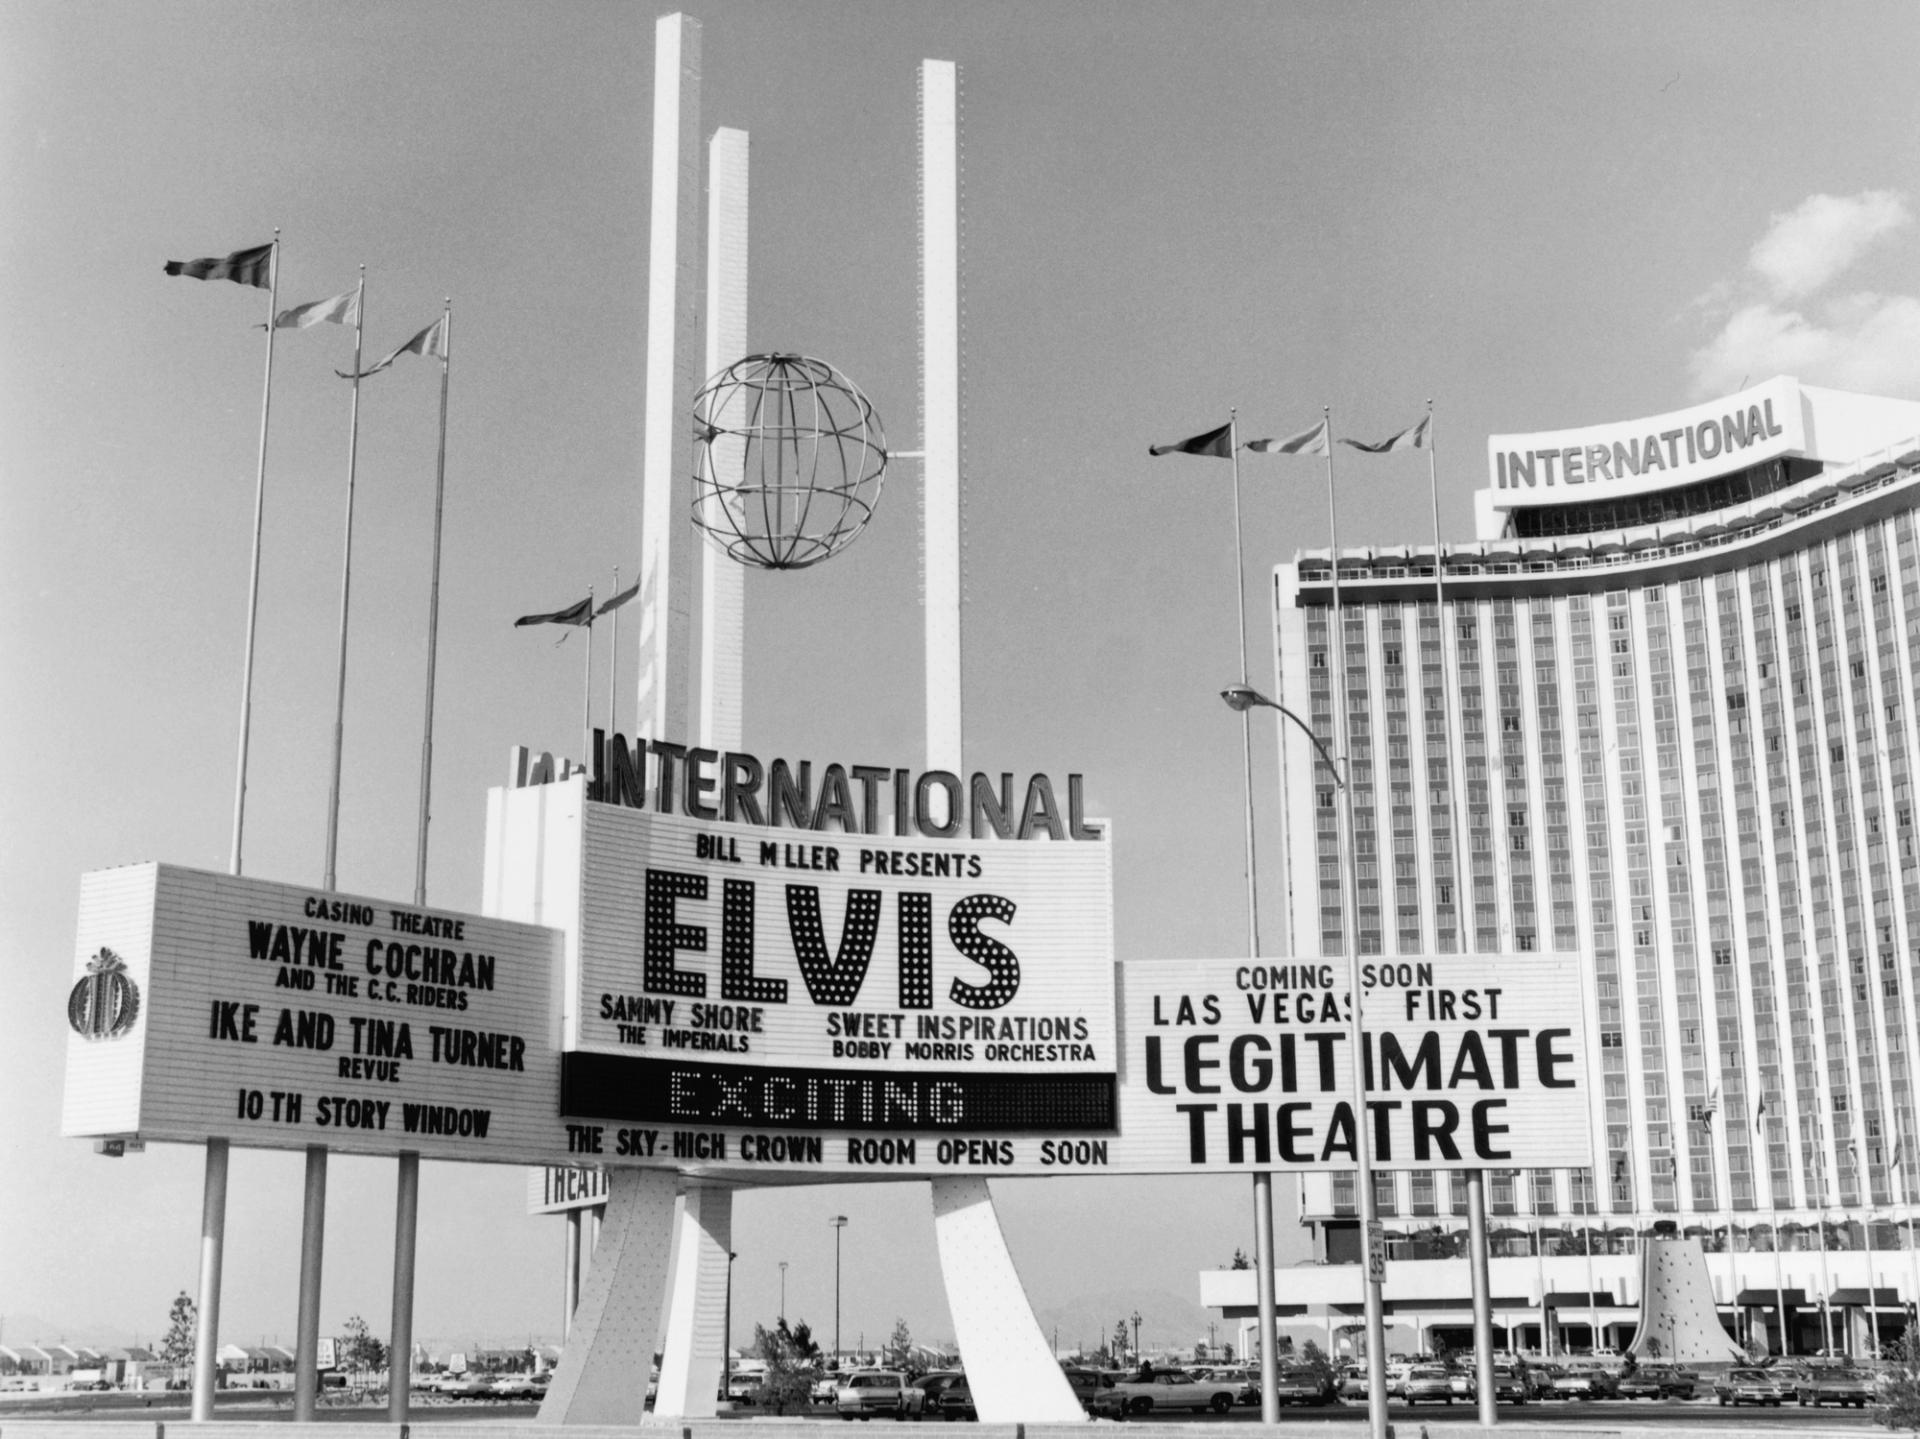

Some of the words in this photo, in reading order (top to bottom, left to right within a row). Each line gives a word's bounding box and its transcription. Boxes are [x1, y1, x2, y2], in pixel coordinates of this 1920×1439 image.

[1496, 397, 1783, 489] INTERNATIONAL
[588, 728, 1106, 841] INTERNATIONAL
[696, 833, 741, 862] BILL
[860, 848, 982, 878] PRESENTS
[304, 897, 375, 926] CASINO
[390, 910, 465, 941] THEATRE
[644, 868, 1022, 1010] ELVIS
[248, 920, 346, 971] WAYNE
[366, 938, 496, 991] COCHRAN
[1236, 964, 1333, 990] COMING
[1361, 963, 1433, 988] SOON
[275, 966, 316, 992] AND
[324, 972, 359, 998] THE
[406, 983, 468, 1011] RIDERS
[1154, 995, 1222, 1026] LAS
[1405, 988, 1502, 1021] FIRST
[600, 993, 676, 1026] SAMMY
[690, 1002, 764, 1033] SHORE
[826, 1012, 905, 1039] SWEET
[917, 1014, 1089, 1041] INSPIRATIONS
[209, 1000, 260, 1043] IKE
[273, 1008, 335, 1051] AND
[349, 1016, 414, 1060] TINA
[429, 1025, 526, 1072] TURNER
[617, 1024, 646, 1045] THE
[662, 1028, 749, 1053] IMPERIALS
[832, 1039, 892, 1059] BOBBY
[905, 1042, 975, 1061] MORRIS
[984, 1043, 1097, 1062] ORCHESTRA
[338, 1056, 400, 1083] REVUE
[1145, 1028, 1576, 1095] LEGITIMATE
[316, 1096, 391, 1130] STORY
[402, 1103, 491, 1138] WINDOW
[670, 1071, 964, 1124] EXCITING
[565, 1124, 604, 1154] THE
[740, 1134, 823, 1163] CROWN
[847, 1138, 916, 1165] ROOM
[936, 1140, 1014, 1166] OPENS
[1040, 1140, 1108, 1166] SOON
[1176, 1098, 1512, 1164] THEATRE
[1371, 1253, 1384, 1275] 35
